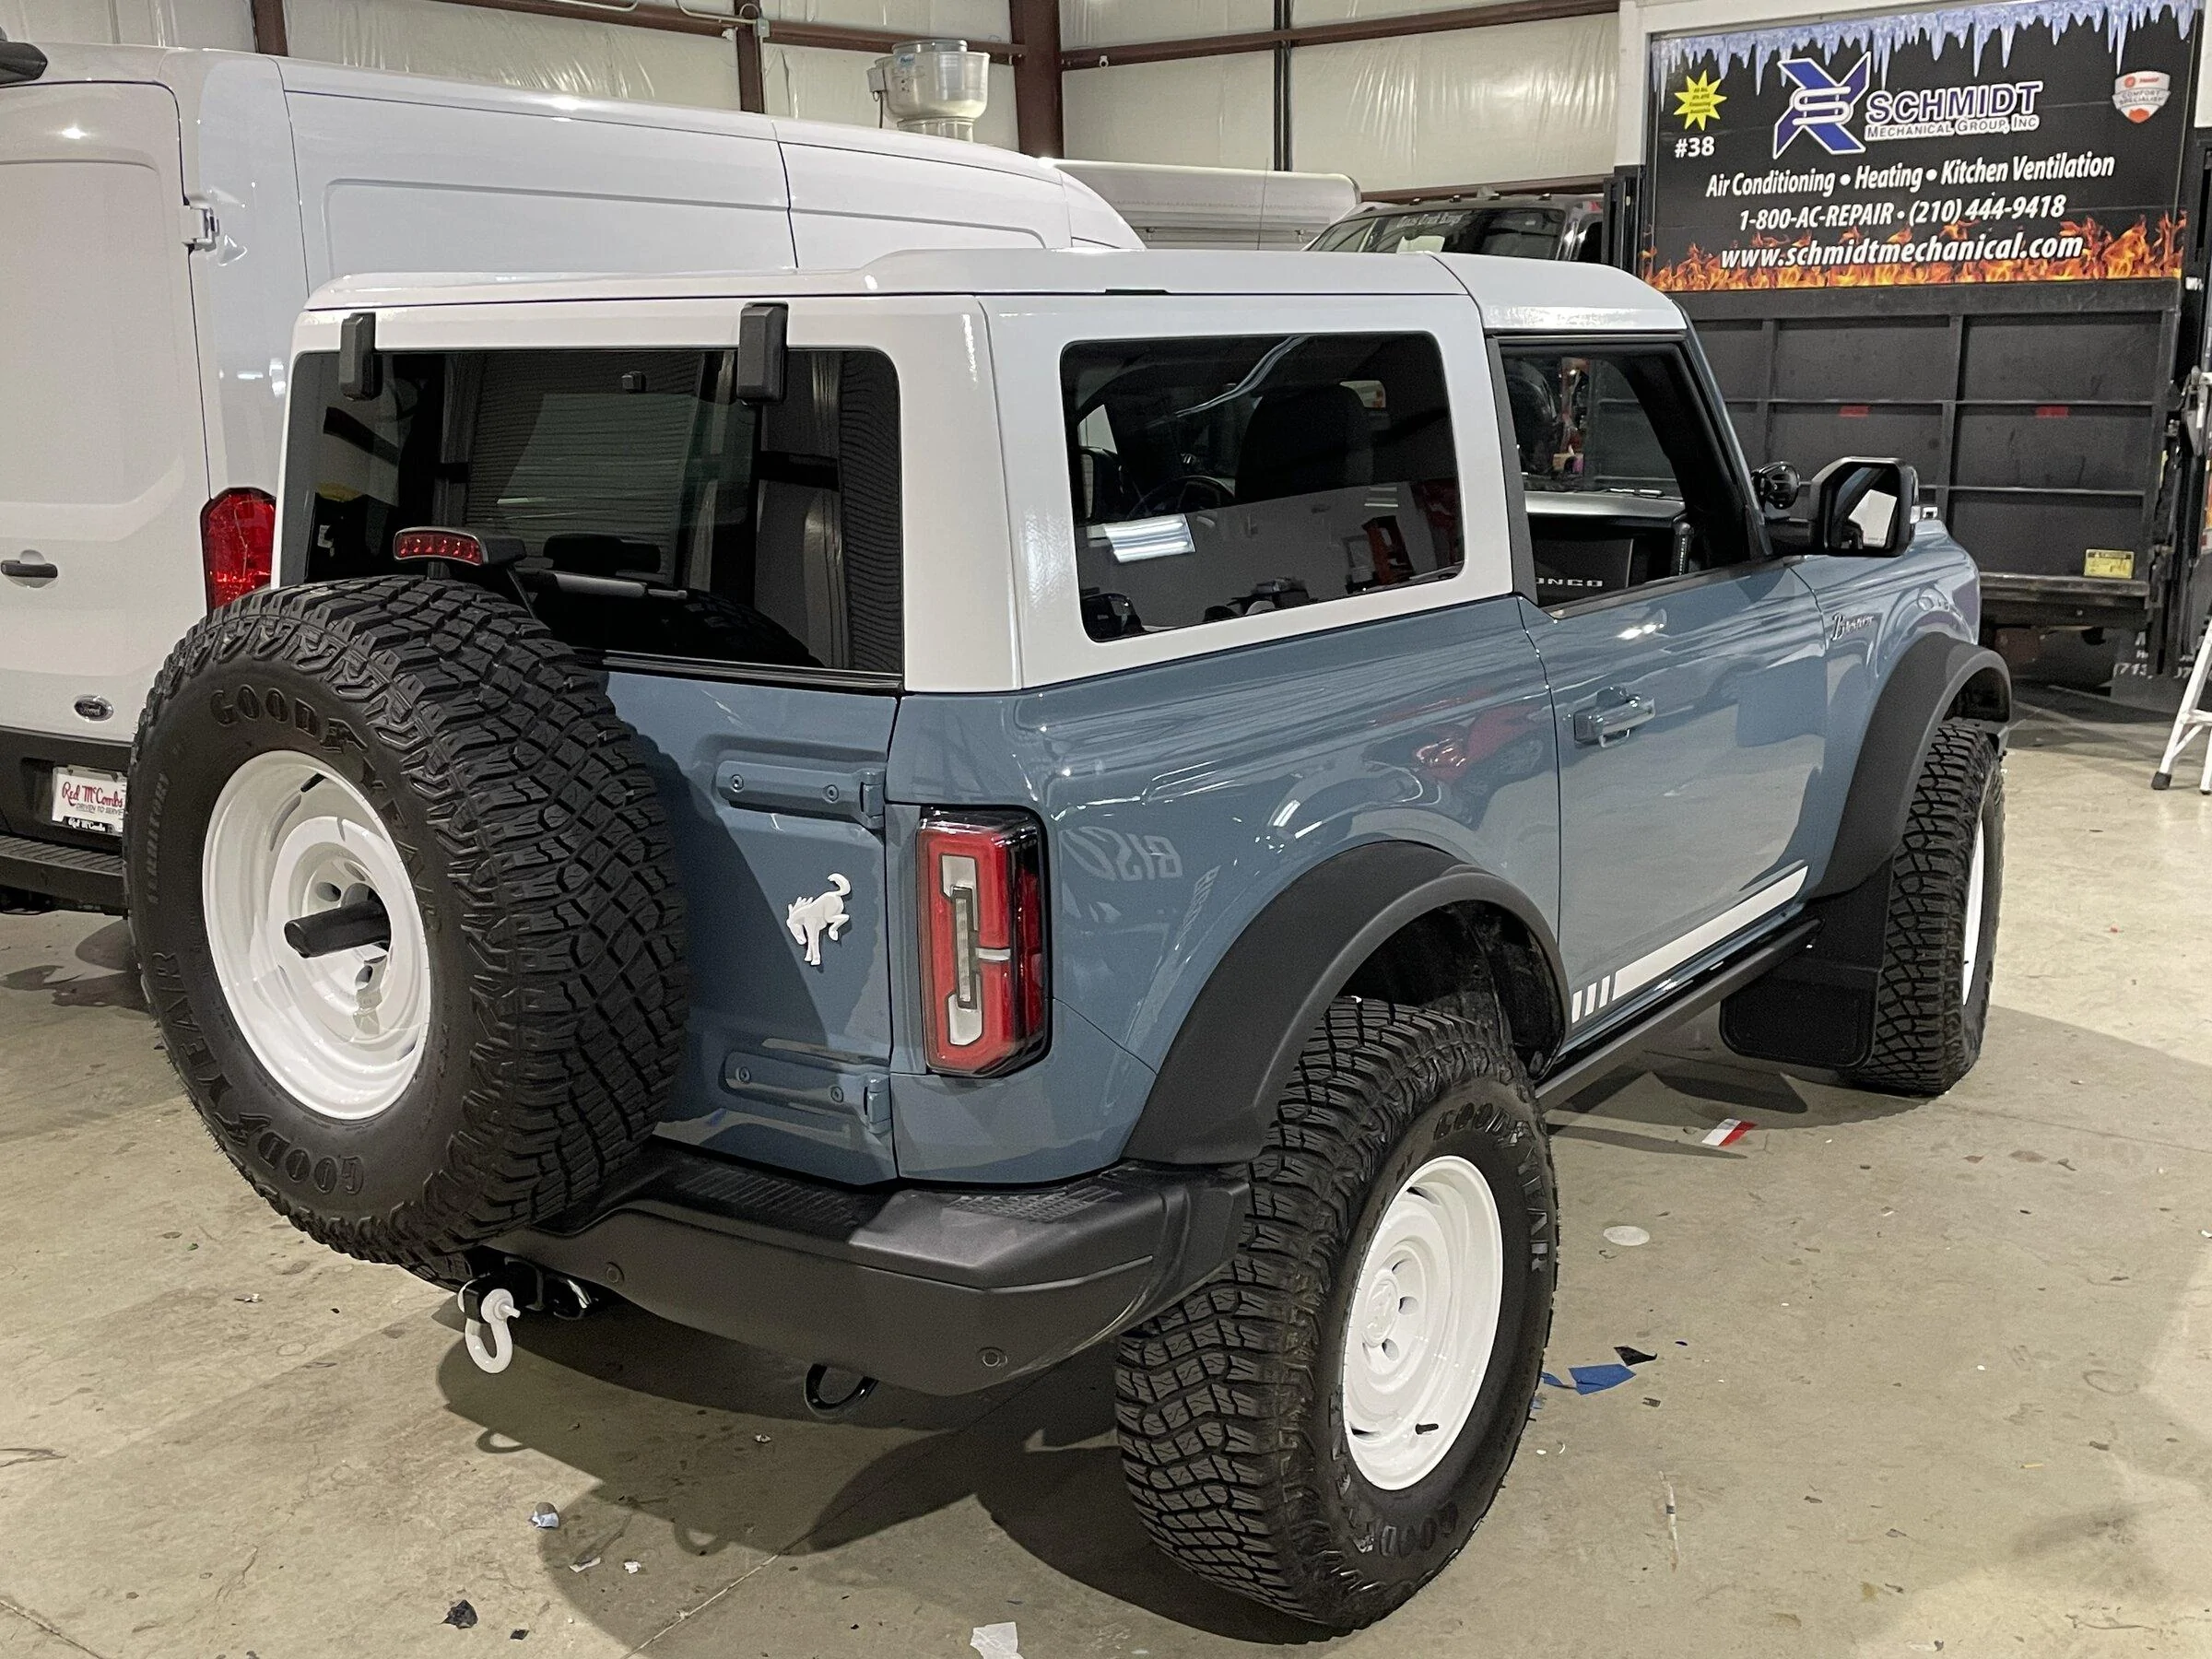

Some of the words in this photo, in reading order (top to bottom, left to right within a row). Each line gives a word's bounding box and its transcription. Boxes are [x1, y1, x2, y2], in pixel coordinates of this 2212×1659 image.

[1865, 81, 2042, 124] SCHMIDT
[1866, 121, 1953, 138] MECHANICAL
[2012, 113, 2039, 130] INC
[1675, 135, 1715, 158] #38
[1705, 173, 1730, 197] Air
[1732, 168, 1836, 197] Conditioning
[1854, 162, 1924, 193] Heating
[1940, 157, 2008, 184] Kitchen
[2012, 151, 2115, 182] Ventilation
[1740, 202, 1894, 230] 1-800-AC-REPAIR
[1909, 198, 1962, 226] (210)
[1965, 194, 2066, 220] 444-9418
[1721, 231, 2084, 268] www.schmidtmechanical.com
[62, 782, 81, 806] Red
